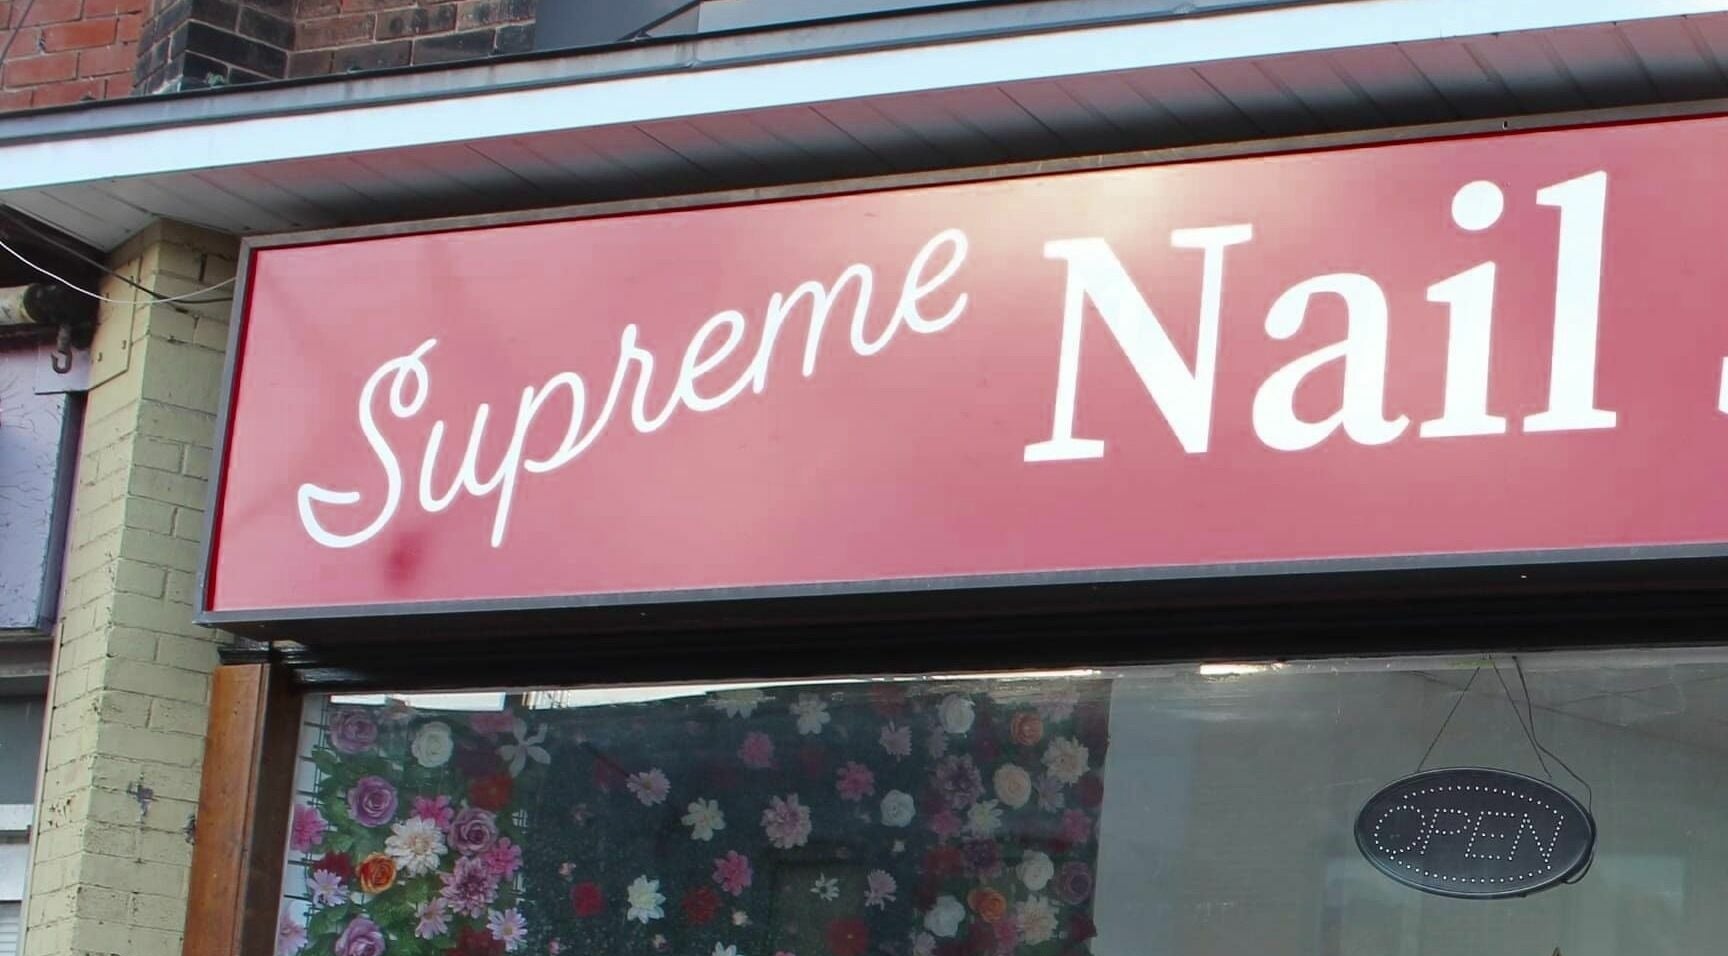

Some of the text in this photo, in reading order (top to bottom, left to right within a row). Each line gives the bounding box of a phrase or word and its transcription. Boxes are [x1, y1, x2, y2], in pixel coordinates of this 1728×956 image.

[297, 227, 969, 548] Supreme
[1023, 169, 1617, 462] Nail
[1374, 804, 1565, 869] OPEN
